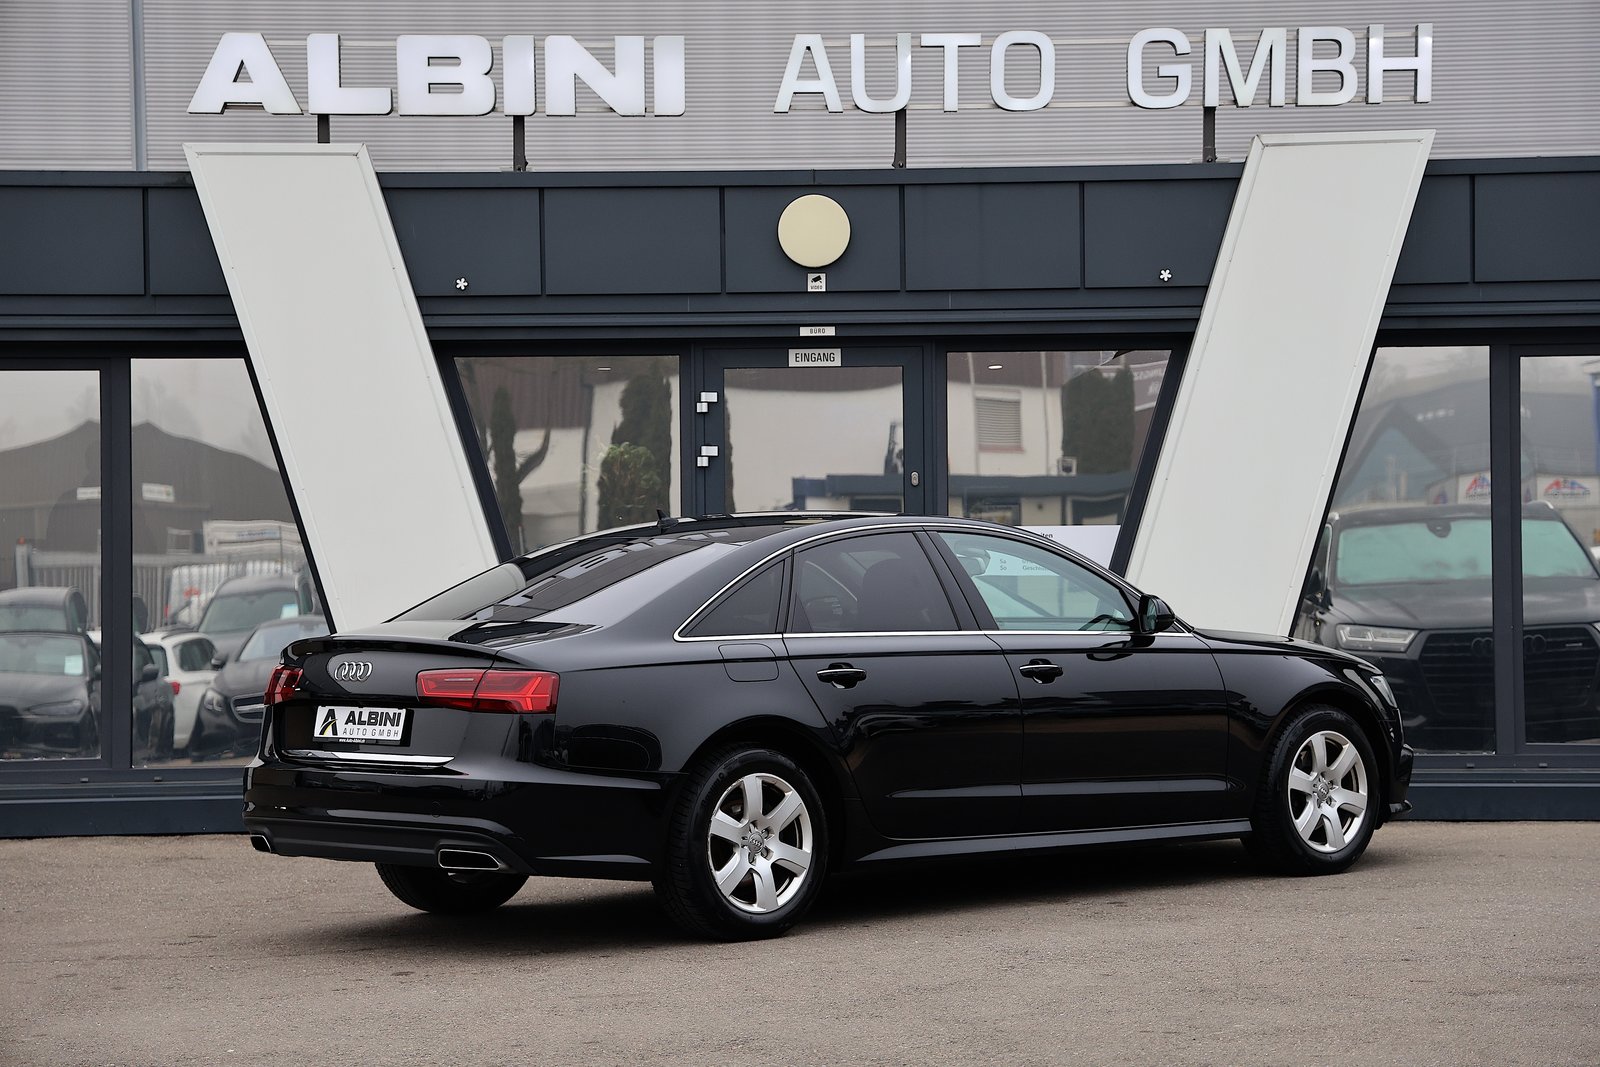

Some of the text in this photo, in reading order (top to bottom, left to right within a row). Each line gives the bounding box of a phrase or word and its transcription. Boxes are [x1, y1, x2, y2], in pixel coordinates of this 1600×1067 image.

[187, 22, 1433, 116] ALBINI AUTO GMBH
[794, 352, 836, 363] EINGANG
[345, 710, 402, 727] ALBINI
[342, 727, 399, 737] AUTO GMBH
